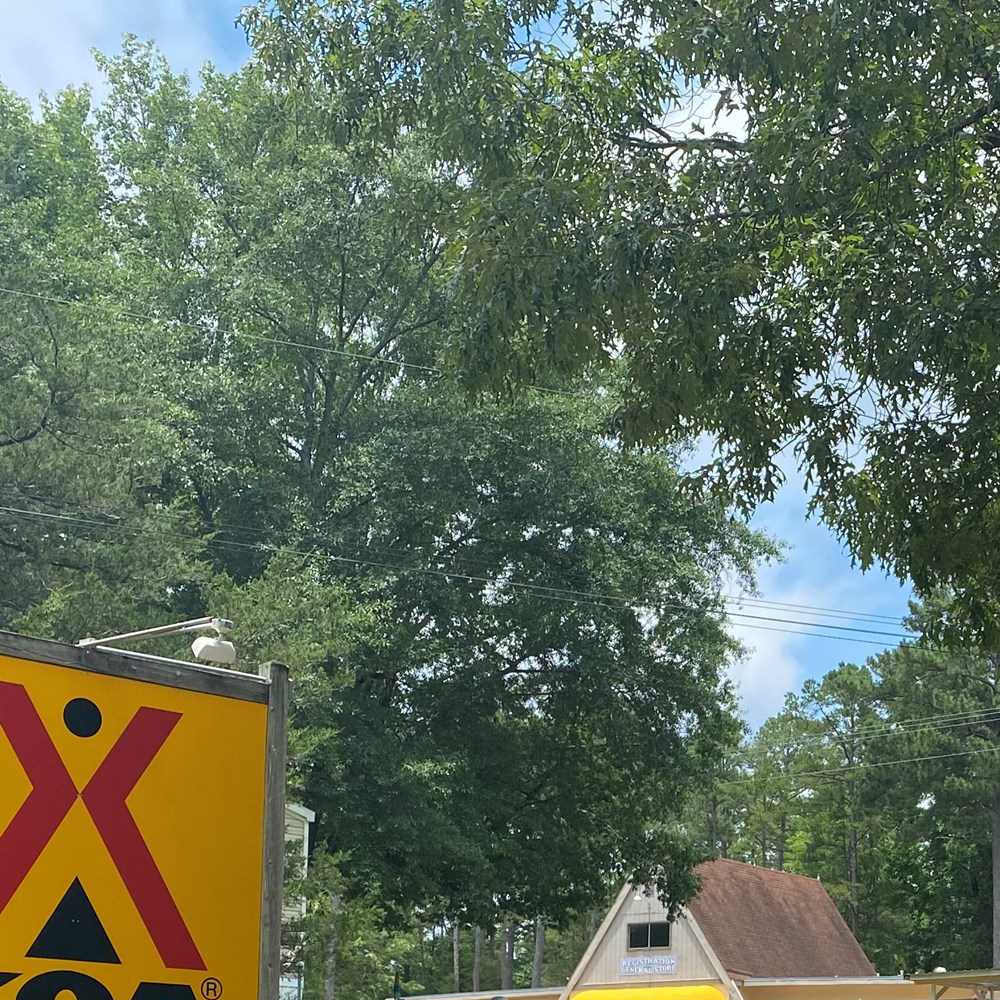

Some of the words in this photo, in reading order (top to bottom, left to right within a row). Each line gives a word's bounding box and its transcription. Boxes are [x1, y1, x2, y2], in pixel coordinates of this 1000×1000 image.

[623, 958, 676, 967] REGISTRATION
[621, 966, 651, 974] GENERAL
[654, 965, 676, 973] STORE
